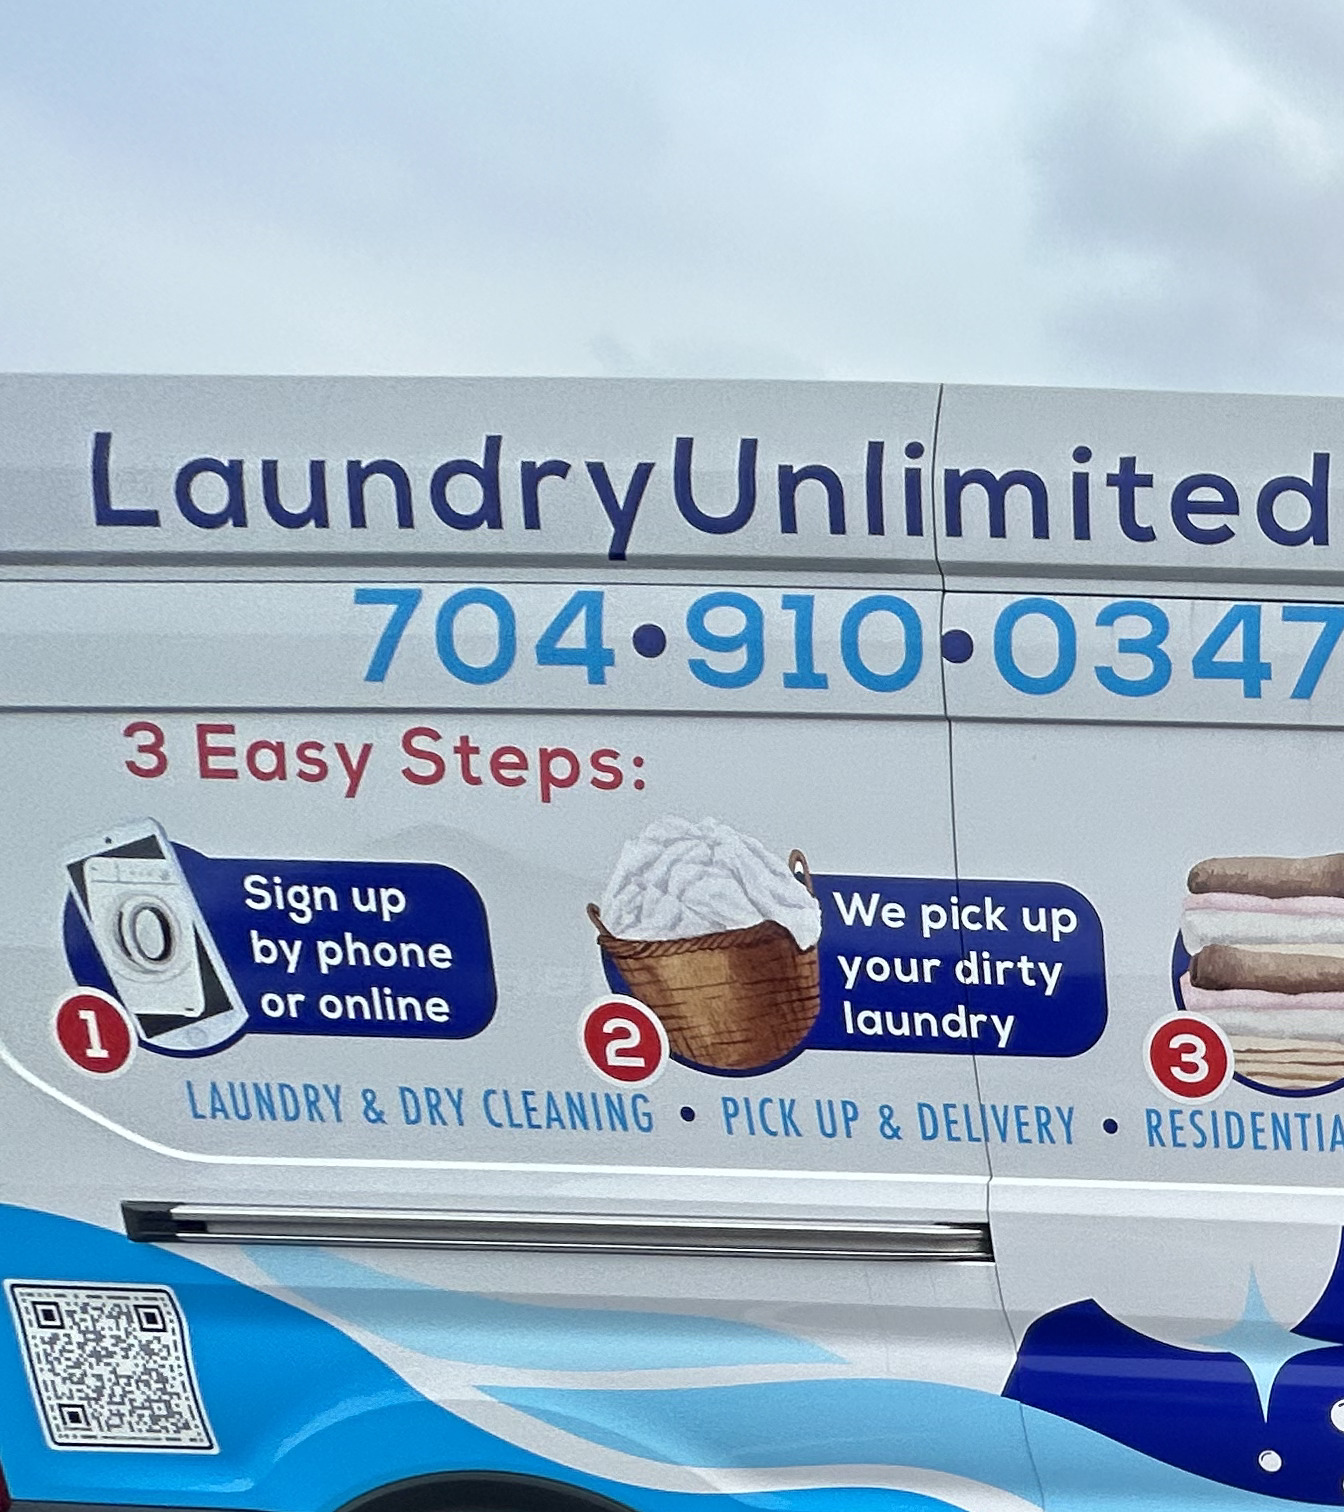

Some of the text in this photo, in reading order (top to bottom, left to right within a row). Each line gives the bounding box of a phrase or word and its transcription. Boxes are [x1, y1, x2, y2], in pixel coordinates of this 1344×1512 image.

[124, 721, 646, 803] 3 Easy Steps:
[244, 874, 408, 924] Sign up
[832, 891, 1078, 938] We pick up
[251, 930, 453, 973] by phone
[838, 950, 1063, 997] your dirty
[261, 986, 450, 1023] or online
[842, 999, 1015, 1048] laundry
[80, 1009, 110, 1061] 1
[602, 1017, 645, 1068] 2
[1170, 1034, 1210, 1085] 3
[184, 1080, 343, 1124] LAUNDRY
[361, 1094, 386, 1125] &
[399, 1086, 465, 1128] DRY
[482, 1089, 655, 1134] CLEANING
[723, 1097, 802, 1137] PICK
[817, 1100, 859, 1140] UP
[878, 1107, 904, 1140] &
[917, 1102, 1075, 1146] DELIVERY
